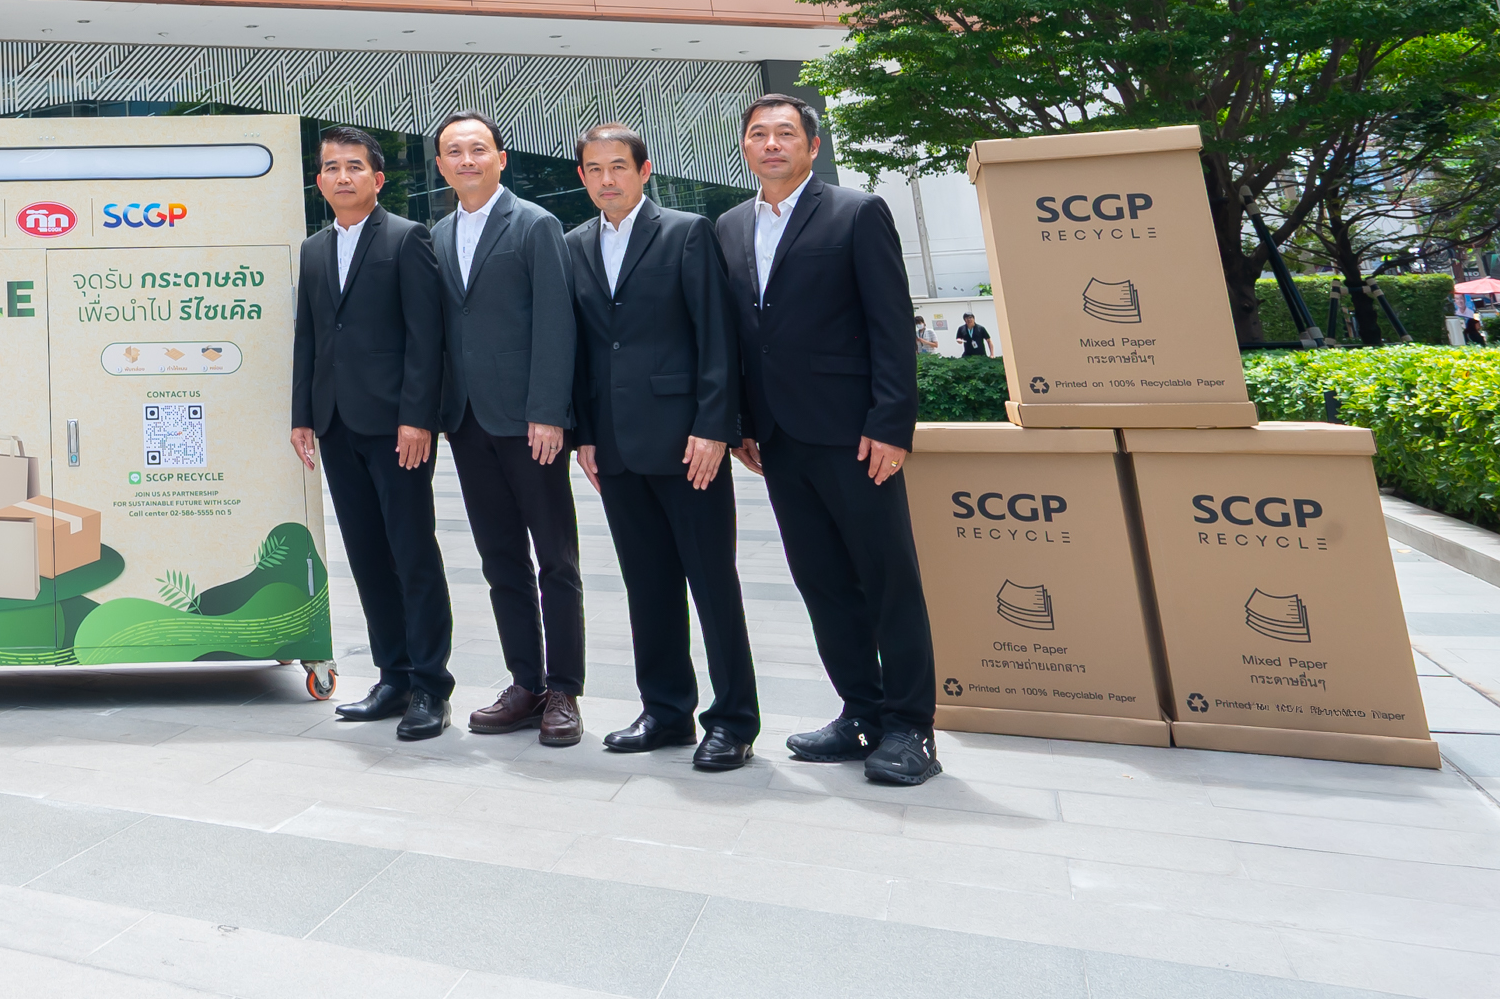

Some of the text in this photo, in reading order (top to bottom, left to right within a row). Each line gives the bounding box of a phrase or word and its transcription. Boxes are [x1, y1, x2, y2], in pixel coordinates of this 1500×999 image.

[103, 203, 187, 228] SCGP
[1035, 192, 1153, 223] SCGP
[1041, 227, 1157, 242] RECYCLE
[72, 265, 265, 297] จุดรับ กระดาษลัง
[78, 294, 262, 322] เพื่อนำไป รีไซเคิล
[1079, 336, 1157, 349] Mixed Paper
[1086, 349, 1156, 366] กระดาษอื่นๆ
[1054, 378, 1226, 390] Printed on 100% Recyclable Paper
[146, 390, 201, 399] CONTACT US
[146, 473, 174, 482] SCGP
[177, 472, 224, 482] RECYCLE
[169, 509, 214, 517] 02-586-5555
[951, 490, 1068, 523] SCGP
[1191, 494, 1323, 529] SCGP
[956, 526, 1071, 544] RECYCLE
[1198, 531, 1328, 551] RECYCLE
[993, 641, 1068, 656] Office Paper
[981, 658, 1086, 674] กระดาษถ่ายเอกสาร
[1242, 654, 1328, 671] Mixed Paper
[1249, 671, 1327, 692] กระดาษอื่นๆ
[968, 683, 1137, 703] Printed on 100% Recyclable Paper
[1215, 699, 1251, 710] Printed
